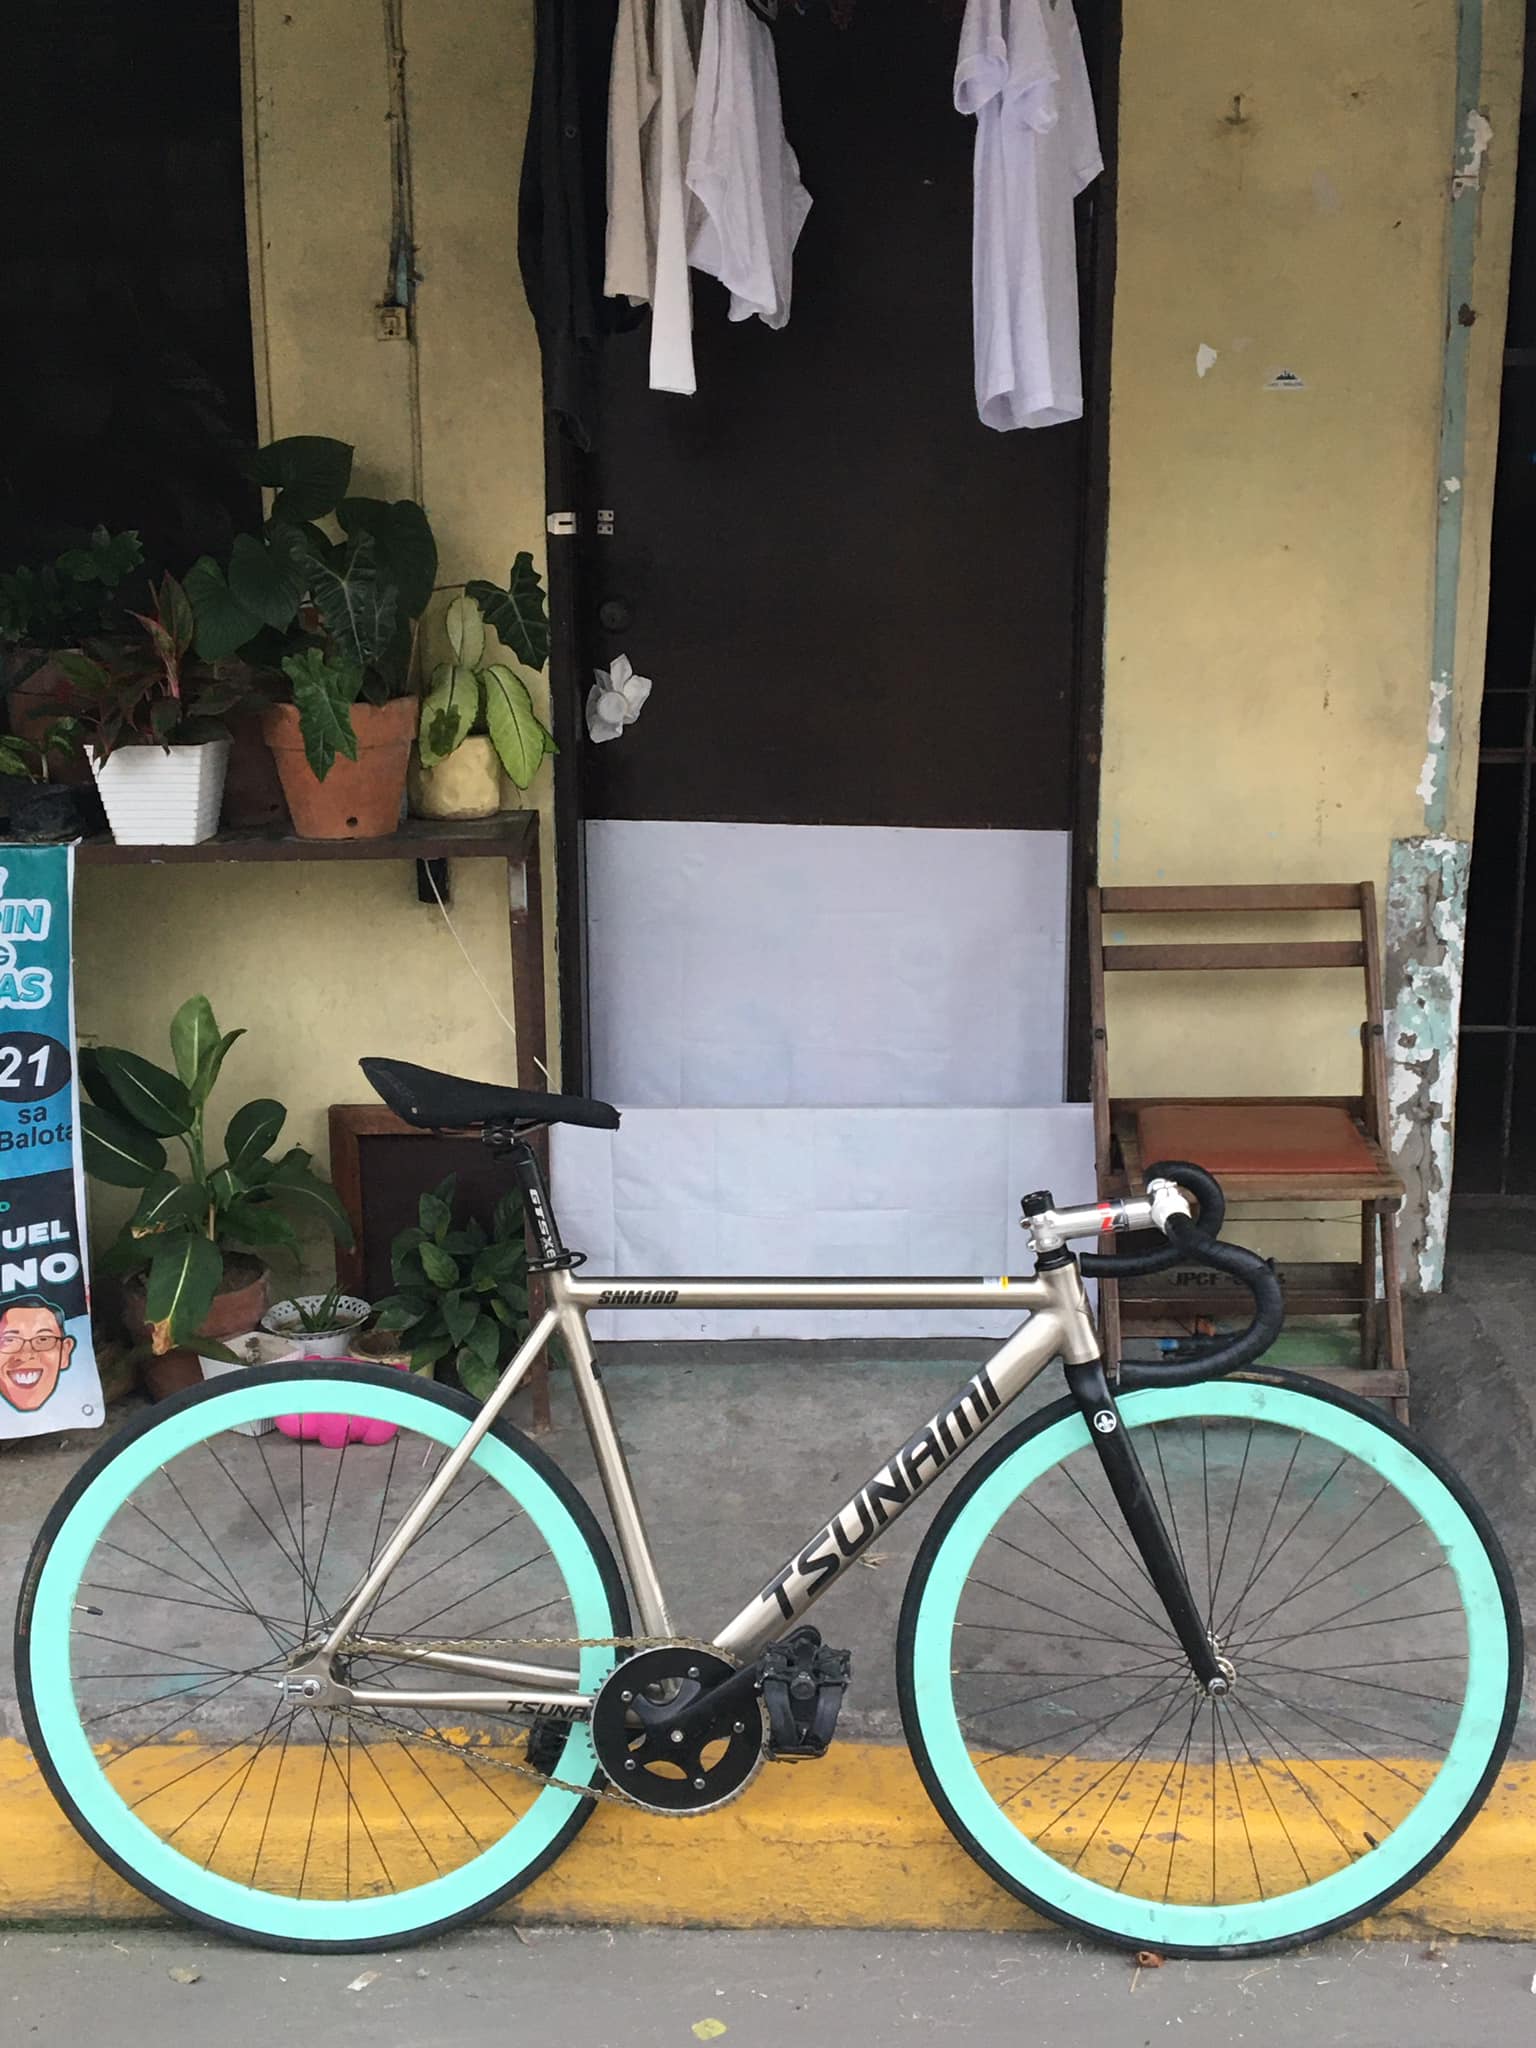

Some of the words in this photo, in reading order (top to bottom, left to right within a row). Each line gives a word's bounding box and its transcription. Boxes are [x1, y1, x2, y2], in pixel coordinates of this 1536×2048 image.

[0, 903, 46, 936] IN
[0, 1045, 50, 1088] 21
[17, 1105, 48, 1125] sa
[2, 1219, 71, 1250] UEL
[1, 1252, 80, 1293] NO
[597, 1289, 679, 1305] SNM100
